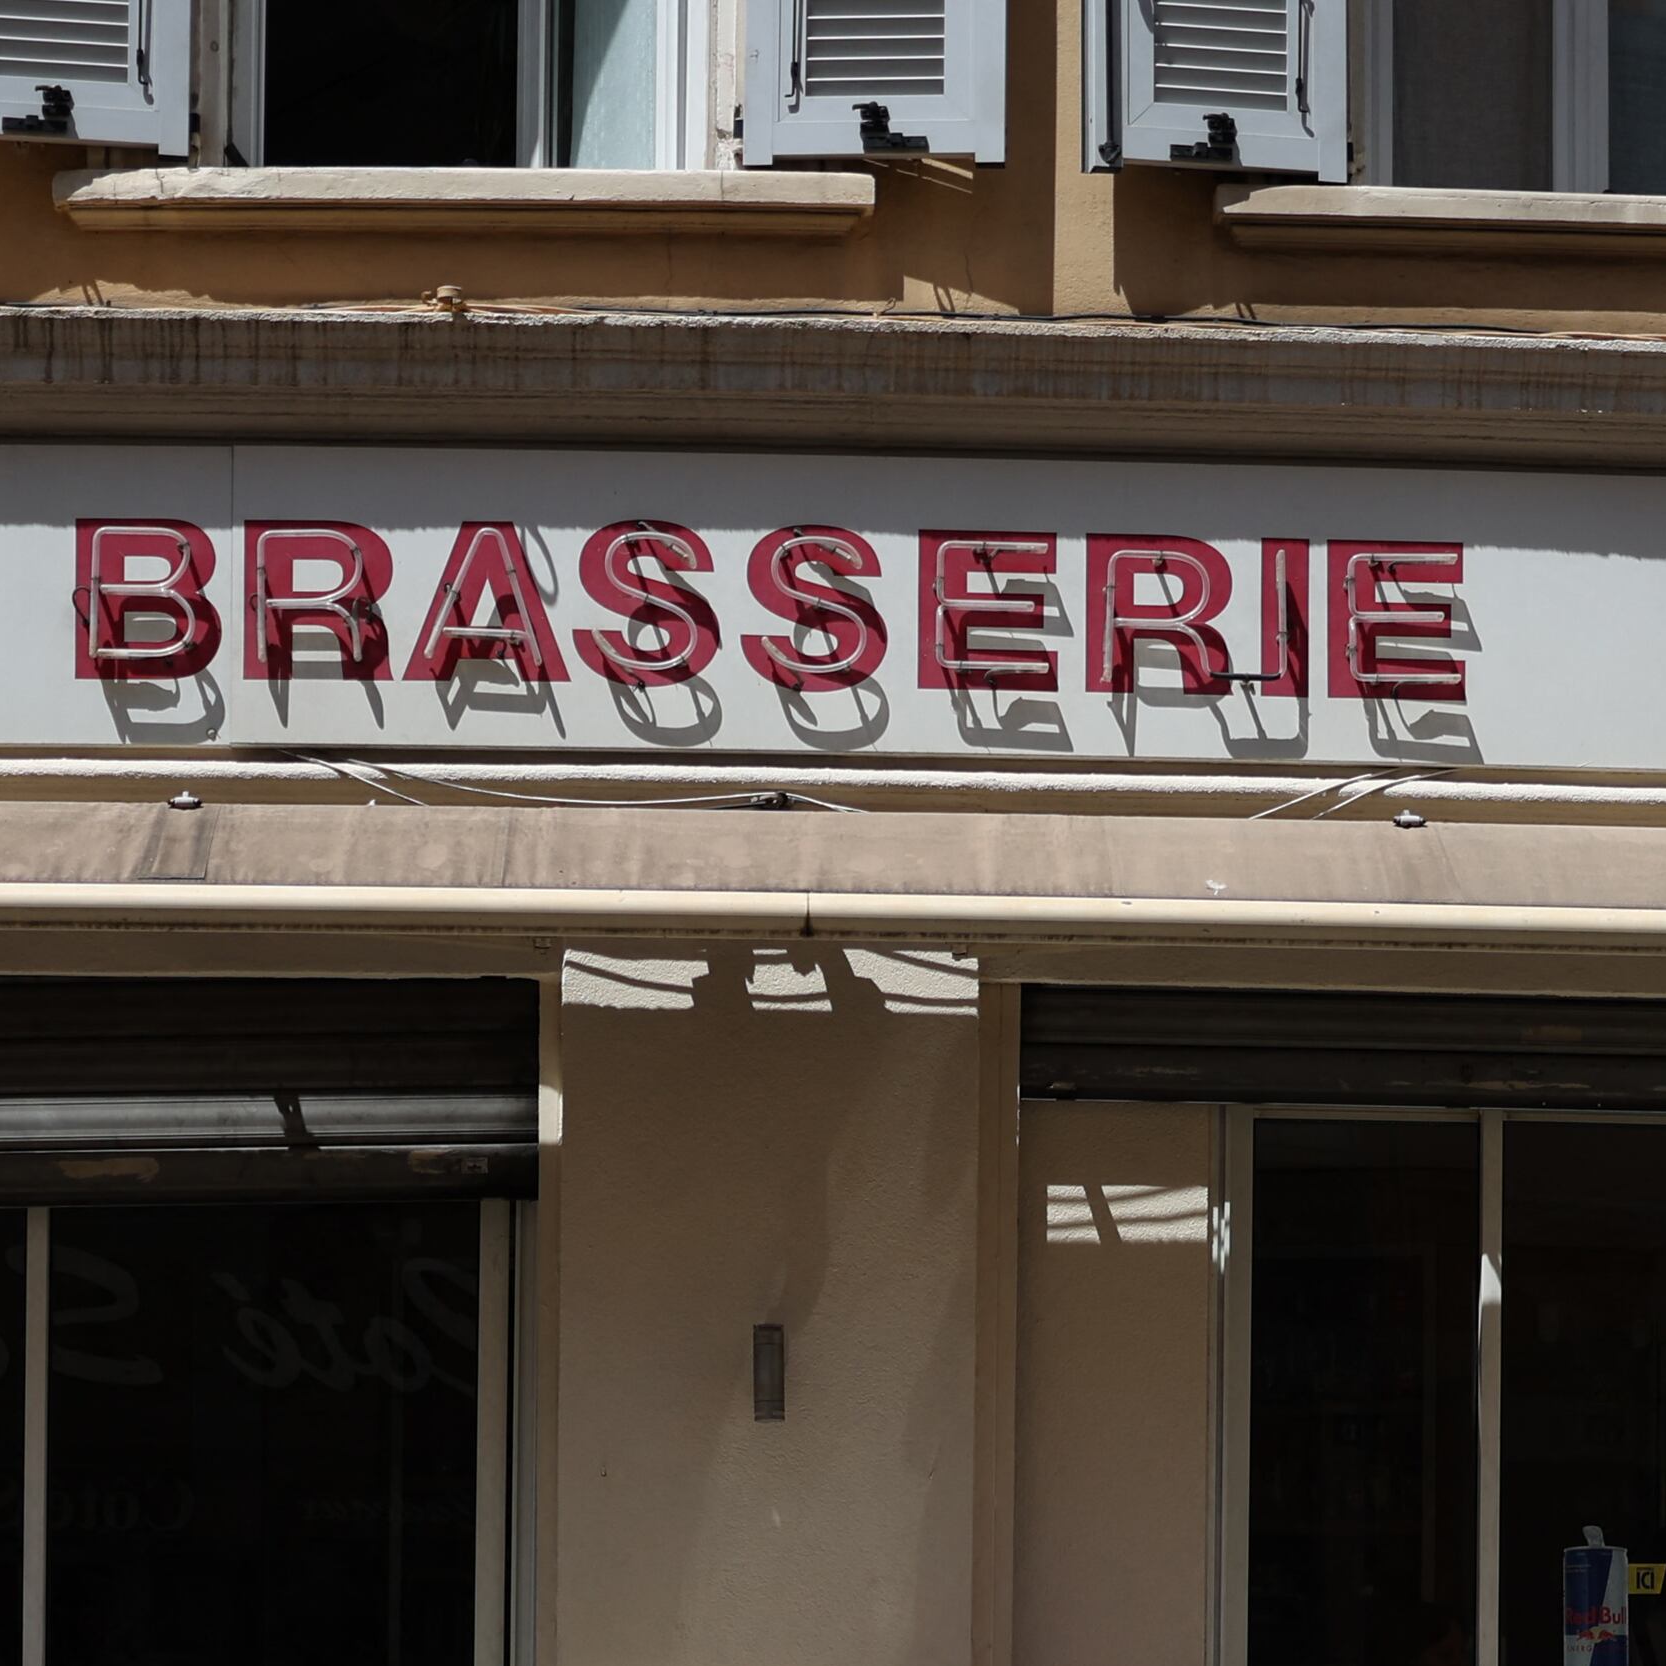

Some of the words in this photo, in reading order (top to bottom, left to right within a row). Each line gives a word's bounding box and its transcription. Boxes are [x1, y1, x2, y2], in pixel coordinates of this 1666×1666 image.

[75, 517, 1466, 701] BRASSERIE
[1636, 1570, 1655, 1590] ICI
[1600, 1606, 1628, 1625] Bull
